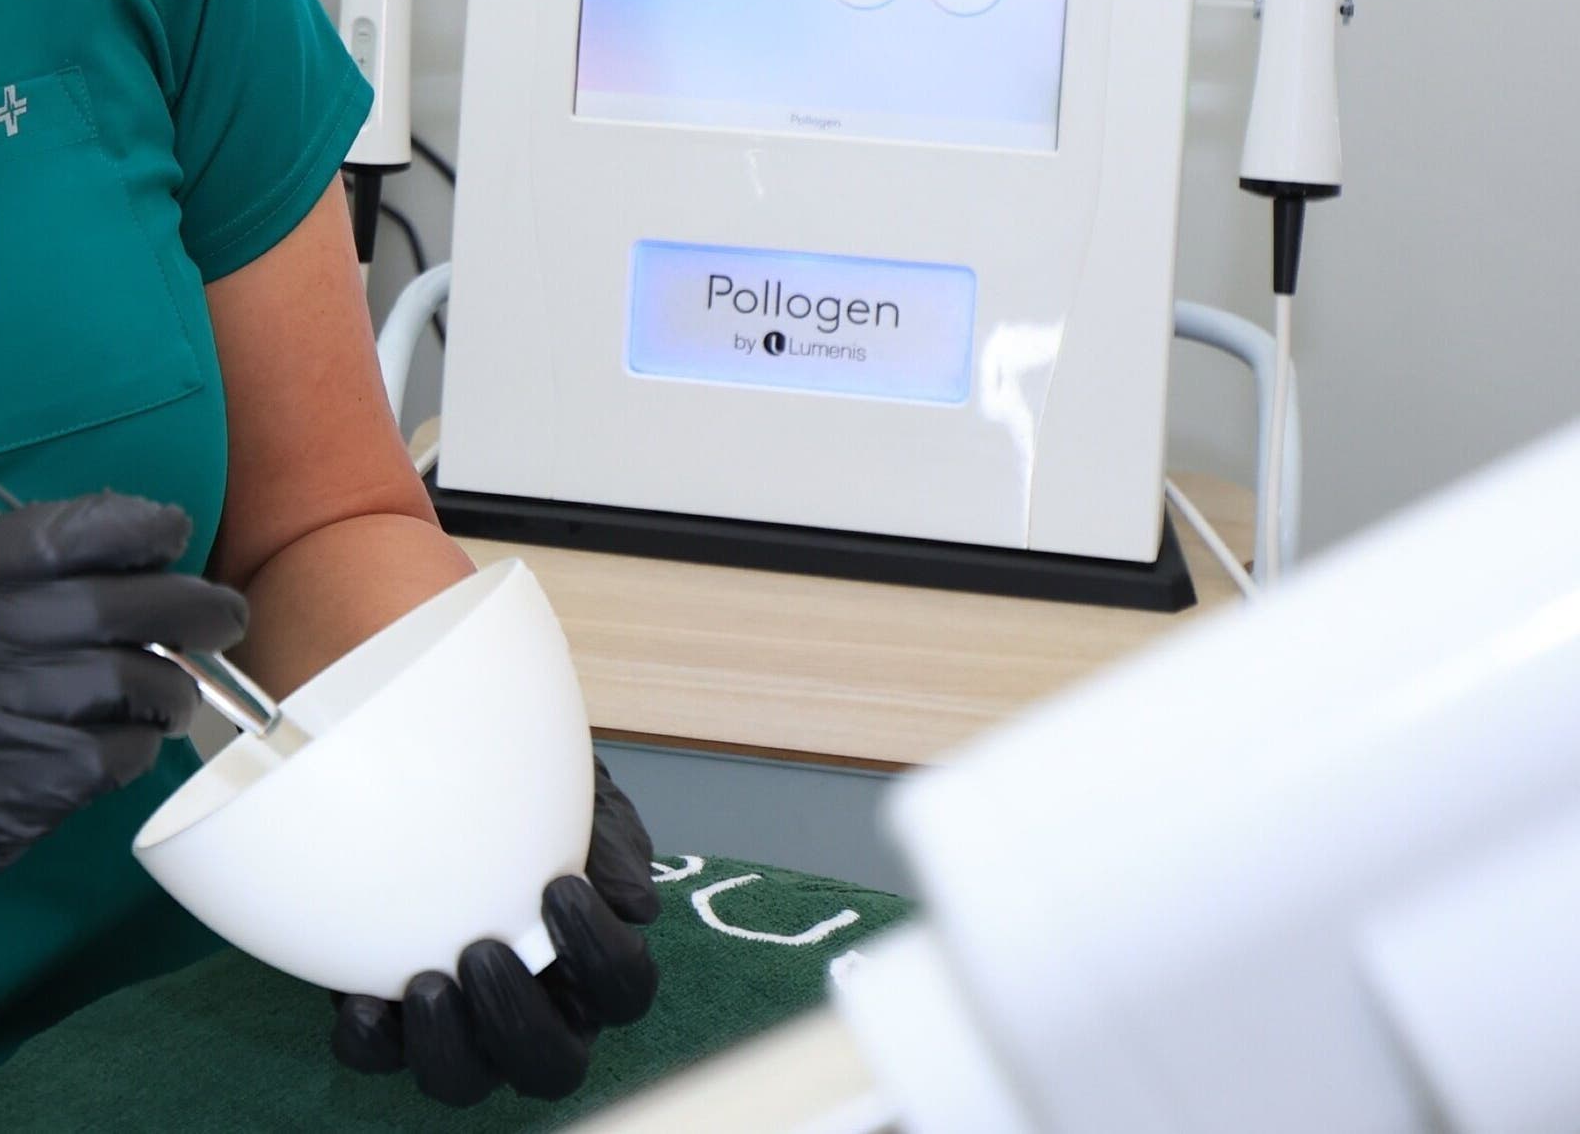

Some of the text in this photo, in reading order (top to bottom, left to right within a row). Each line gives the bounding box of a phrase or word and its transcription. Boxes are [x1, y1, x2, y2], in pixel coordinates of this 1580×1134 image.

[707, 274, 900, 333] Pollogen
[734, 333, 867, 362] by Lumenis
